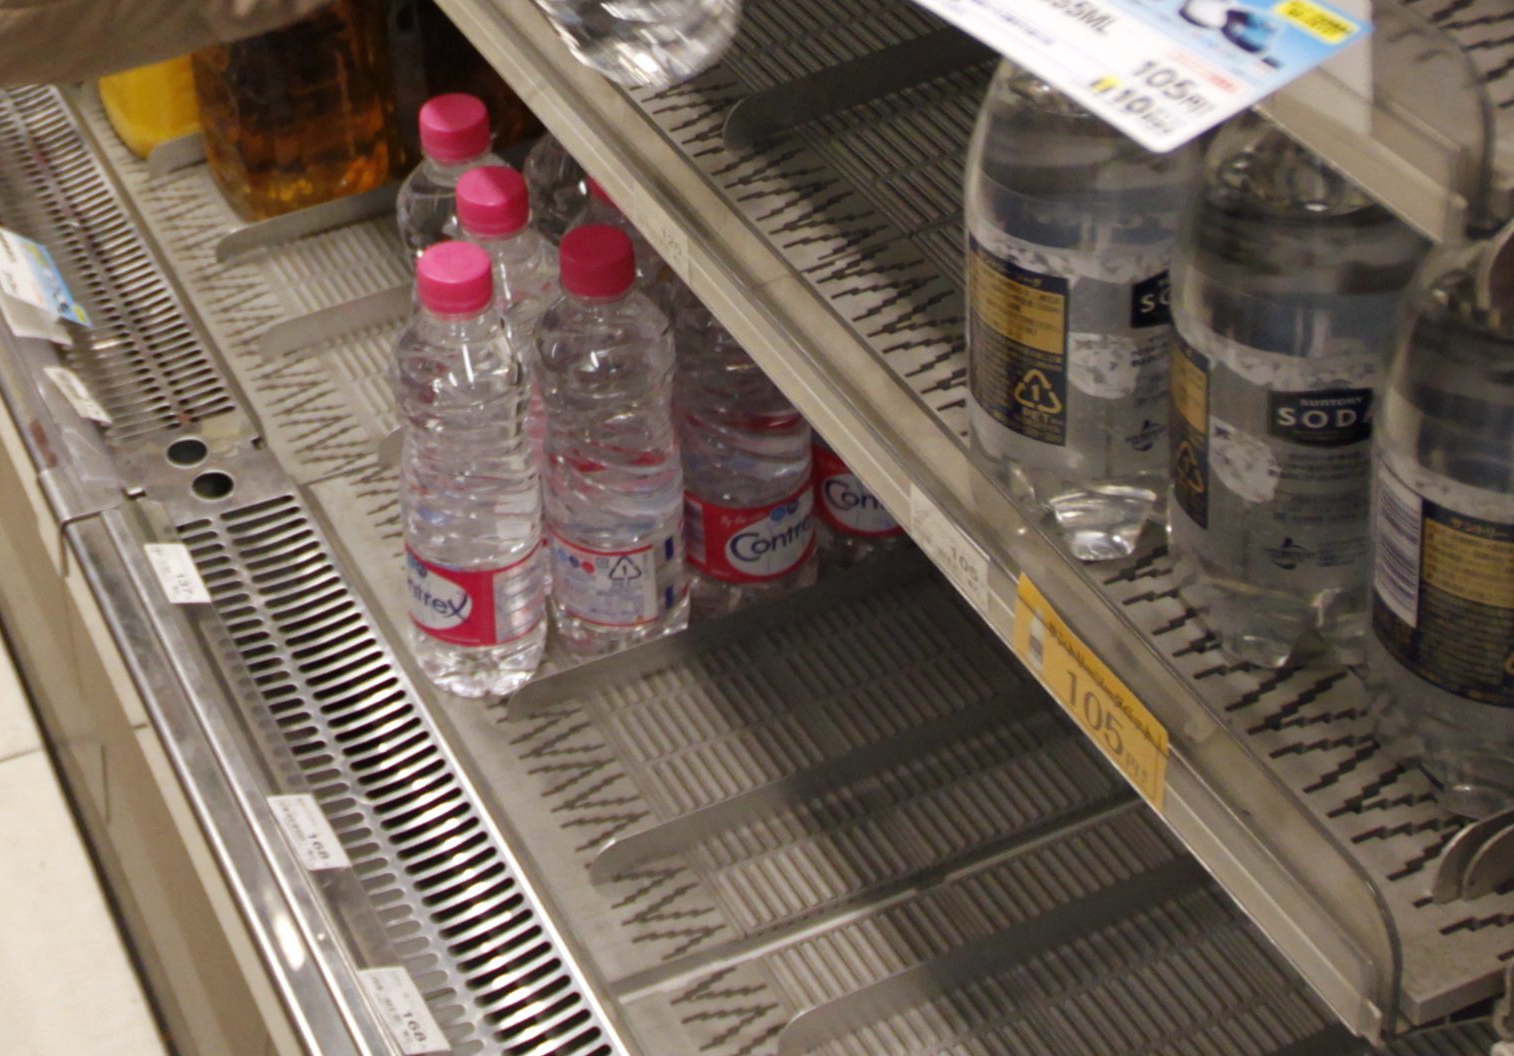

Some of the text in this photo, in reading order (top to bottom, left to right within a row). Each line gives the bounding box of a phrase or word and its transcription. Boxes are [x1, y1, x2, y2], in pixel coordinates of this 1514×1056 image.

[950, 547, 980, 583] 105
[307, 832, 330, 861] 168
[402, 1010, 429, 1043] 168
